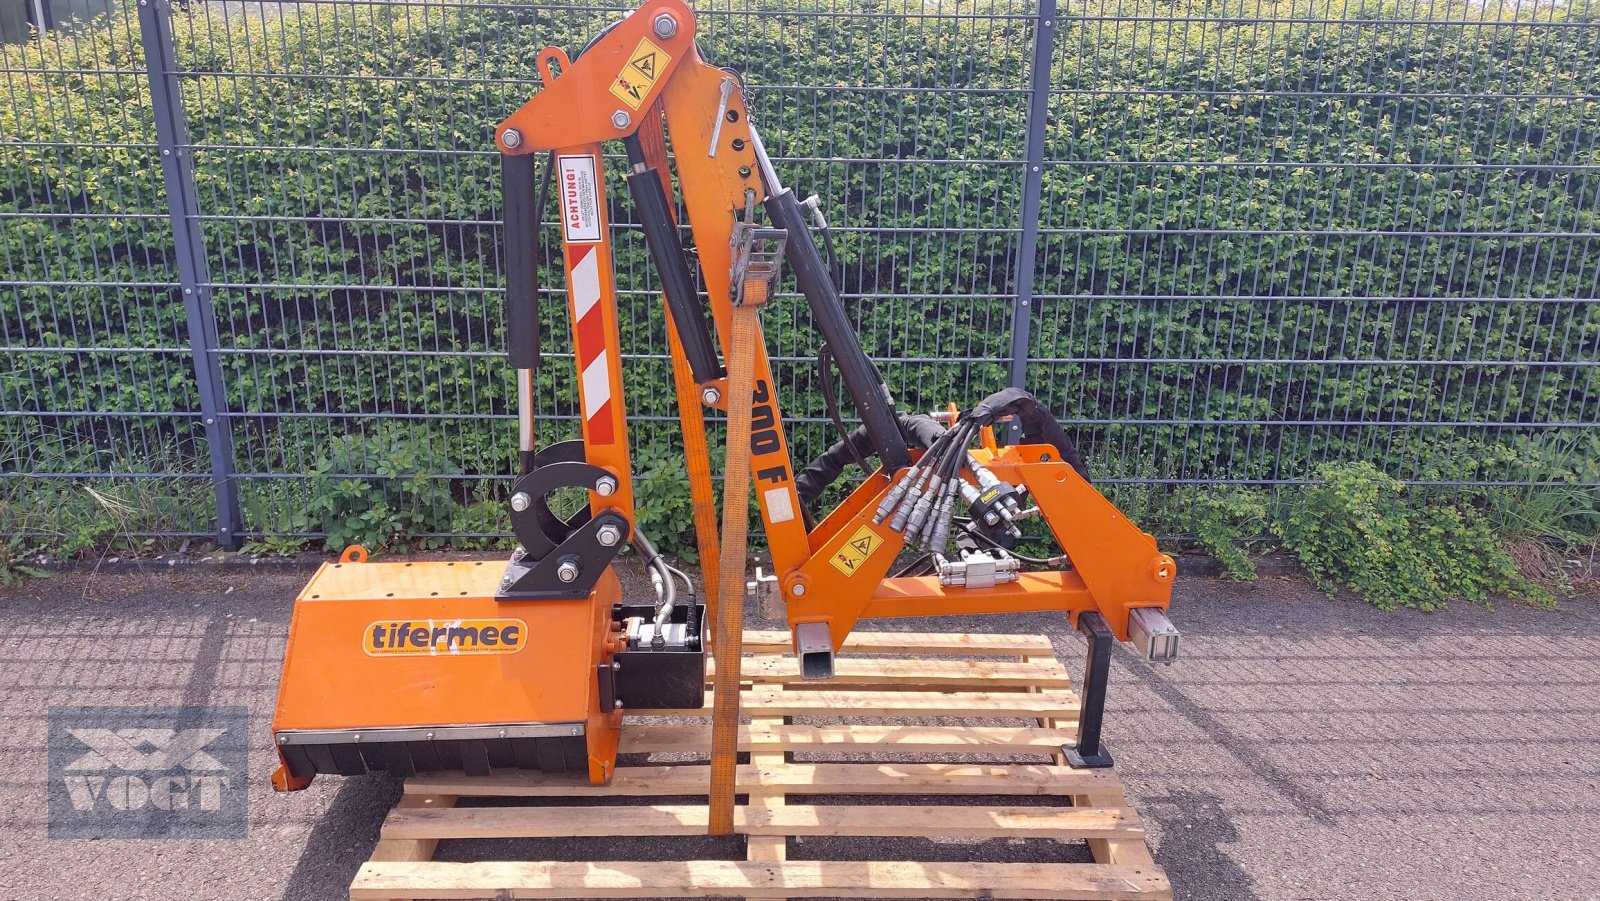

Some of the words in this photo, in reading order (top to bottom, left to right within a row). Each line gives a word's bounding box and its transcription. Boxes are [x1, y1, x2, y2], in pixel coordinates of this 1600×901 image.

[566, 169, 580, 229] ACHTUNG!
[757, 465, 788, 484] F
[372, 622, 520, 648] tifermec
